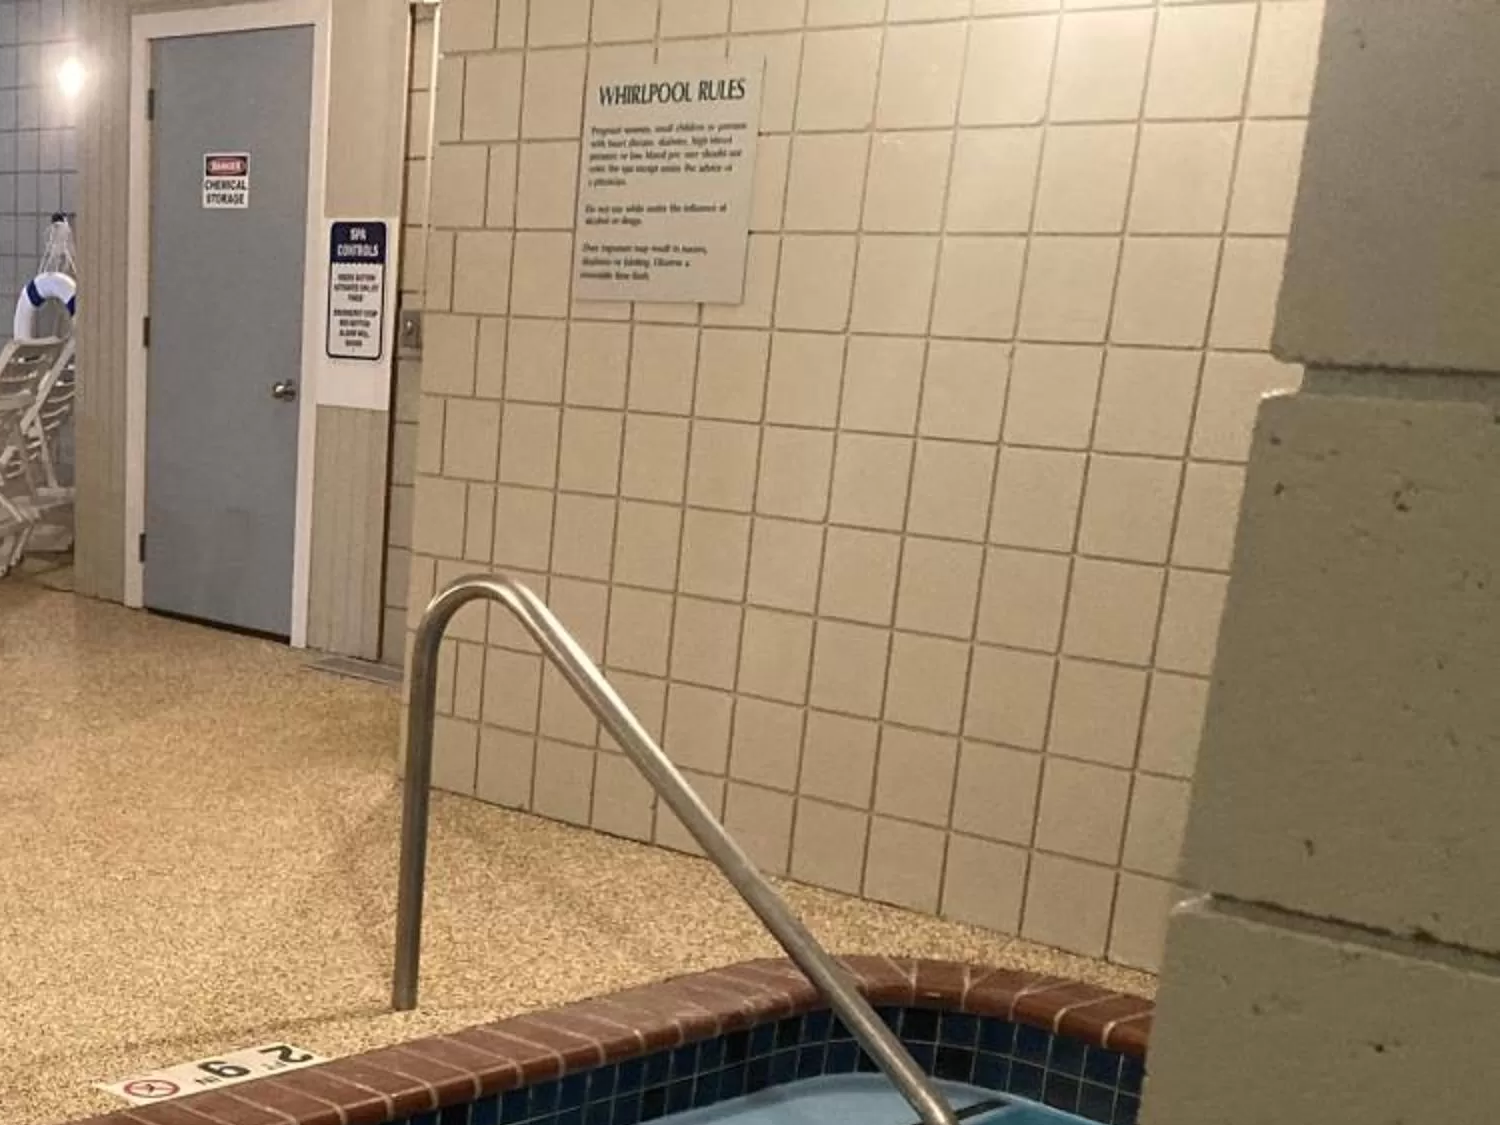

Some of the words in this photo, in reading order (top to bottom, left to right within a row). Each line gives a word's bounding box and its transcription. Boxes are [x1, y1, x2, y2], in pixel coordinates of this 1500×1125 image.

[599, 82, 692, 105] WHIRLPOOL
[698, 78, 745, 101] RULES
[204, 179, 247, 190] CHEMICAL
[206, 193, 245, 205] STORAGE
[350, 227, 367, 241] SPA
[337, 242, 379, 257] CONTROLS
[257, 1045, 314, 1063] 2
